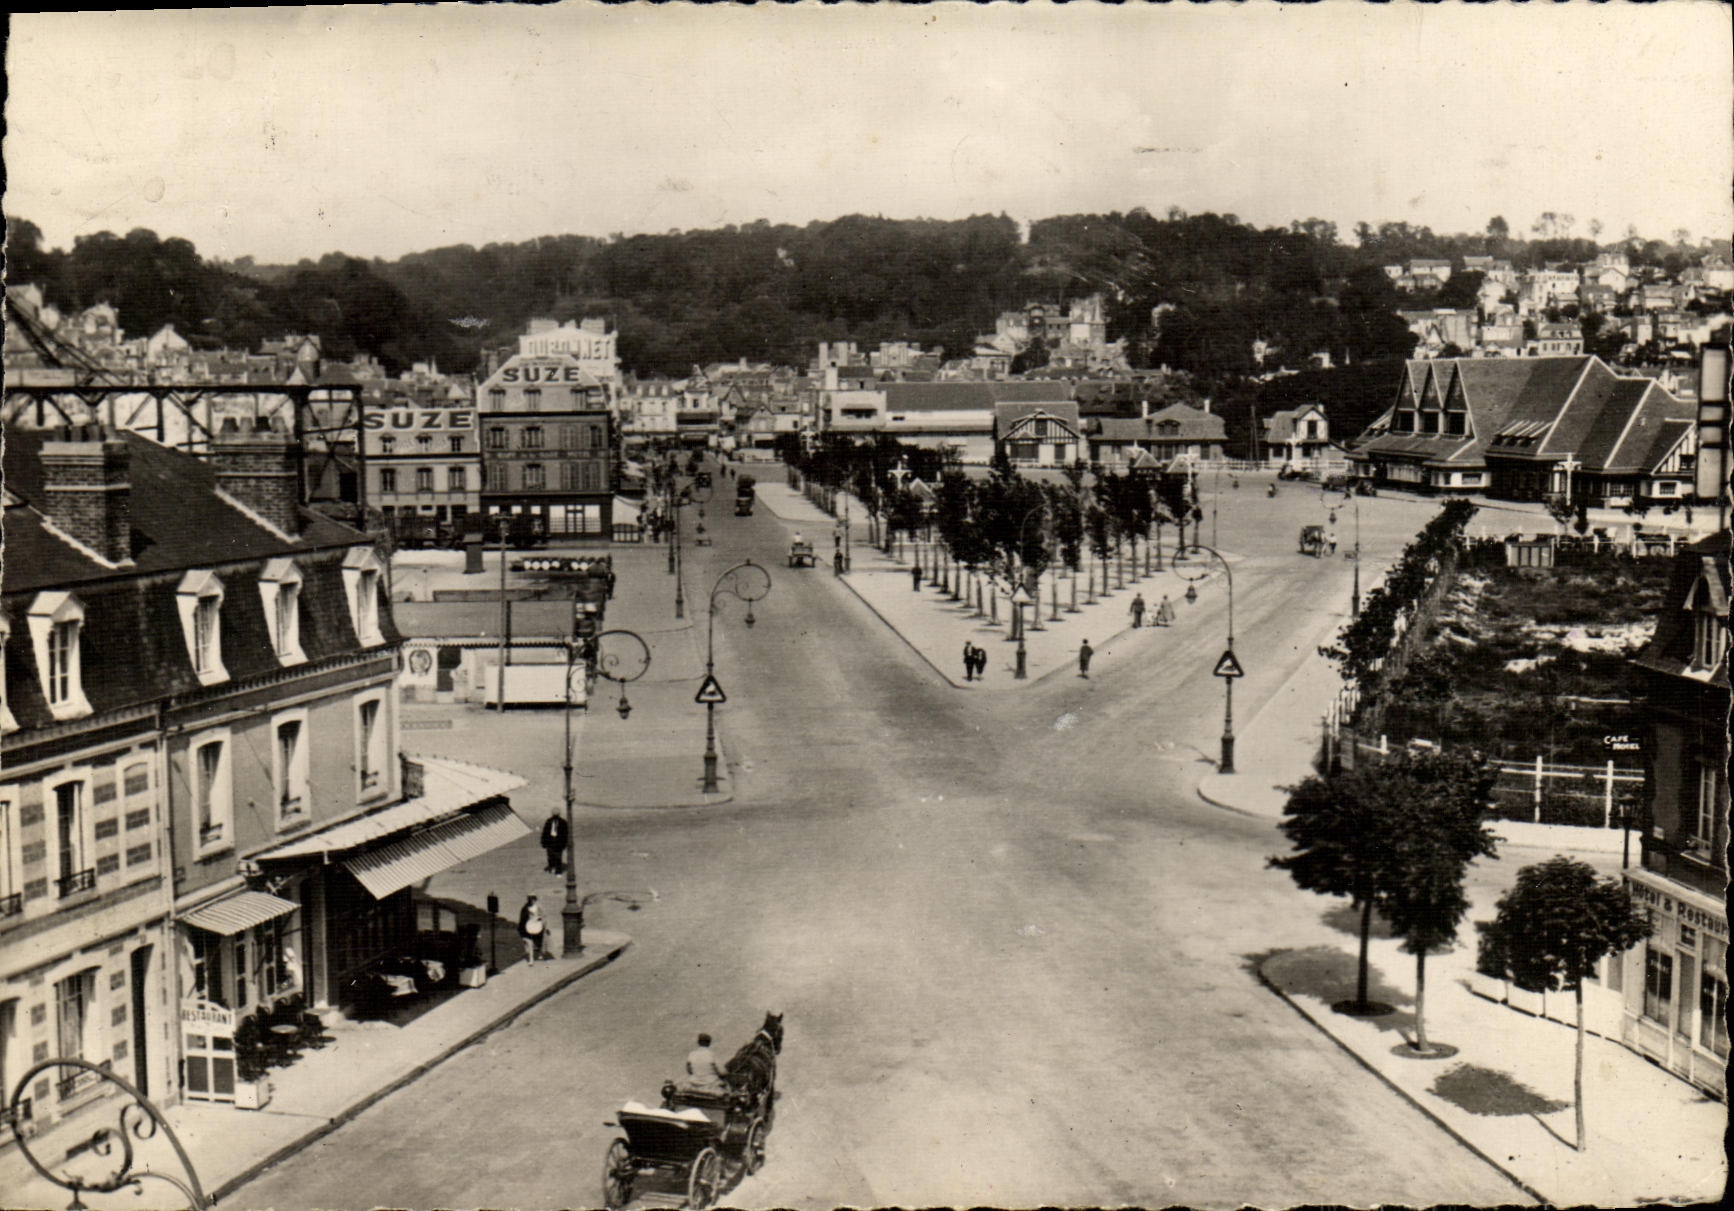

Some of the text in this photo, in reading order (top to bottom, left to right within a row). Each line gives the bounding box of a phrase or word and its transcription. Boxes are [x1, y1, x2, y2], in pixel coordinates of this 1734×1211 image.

[503, 366, 580, 382] SUZE
[363, 411, 472, 430] SUZE
[182, 1010, 231, 1024] RESTAURANT
